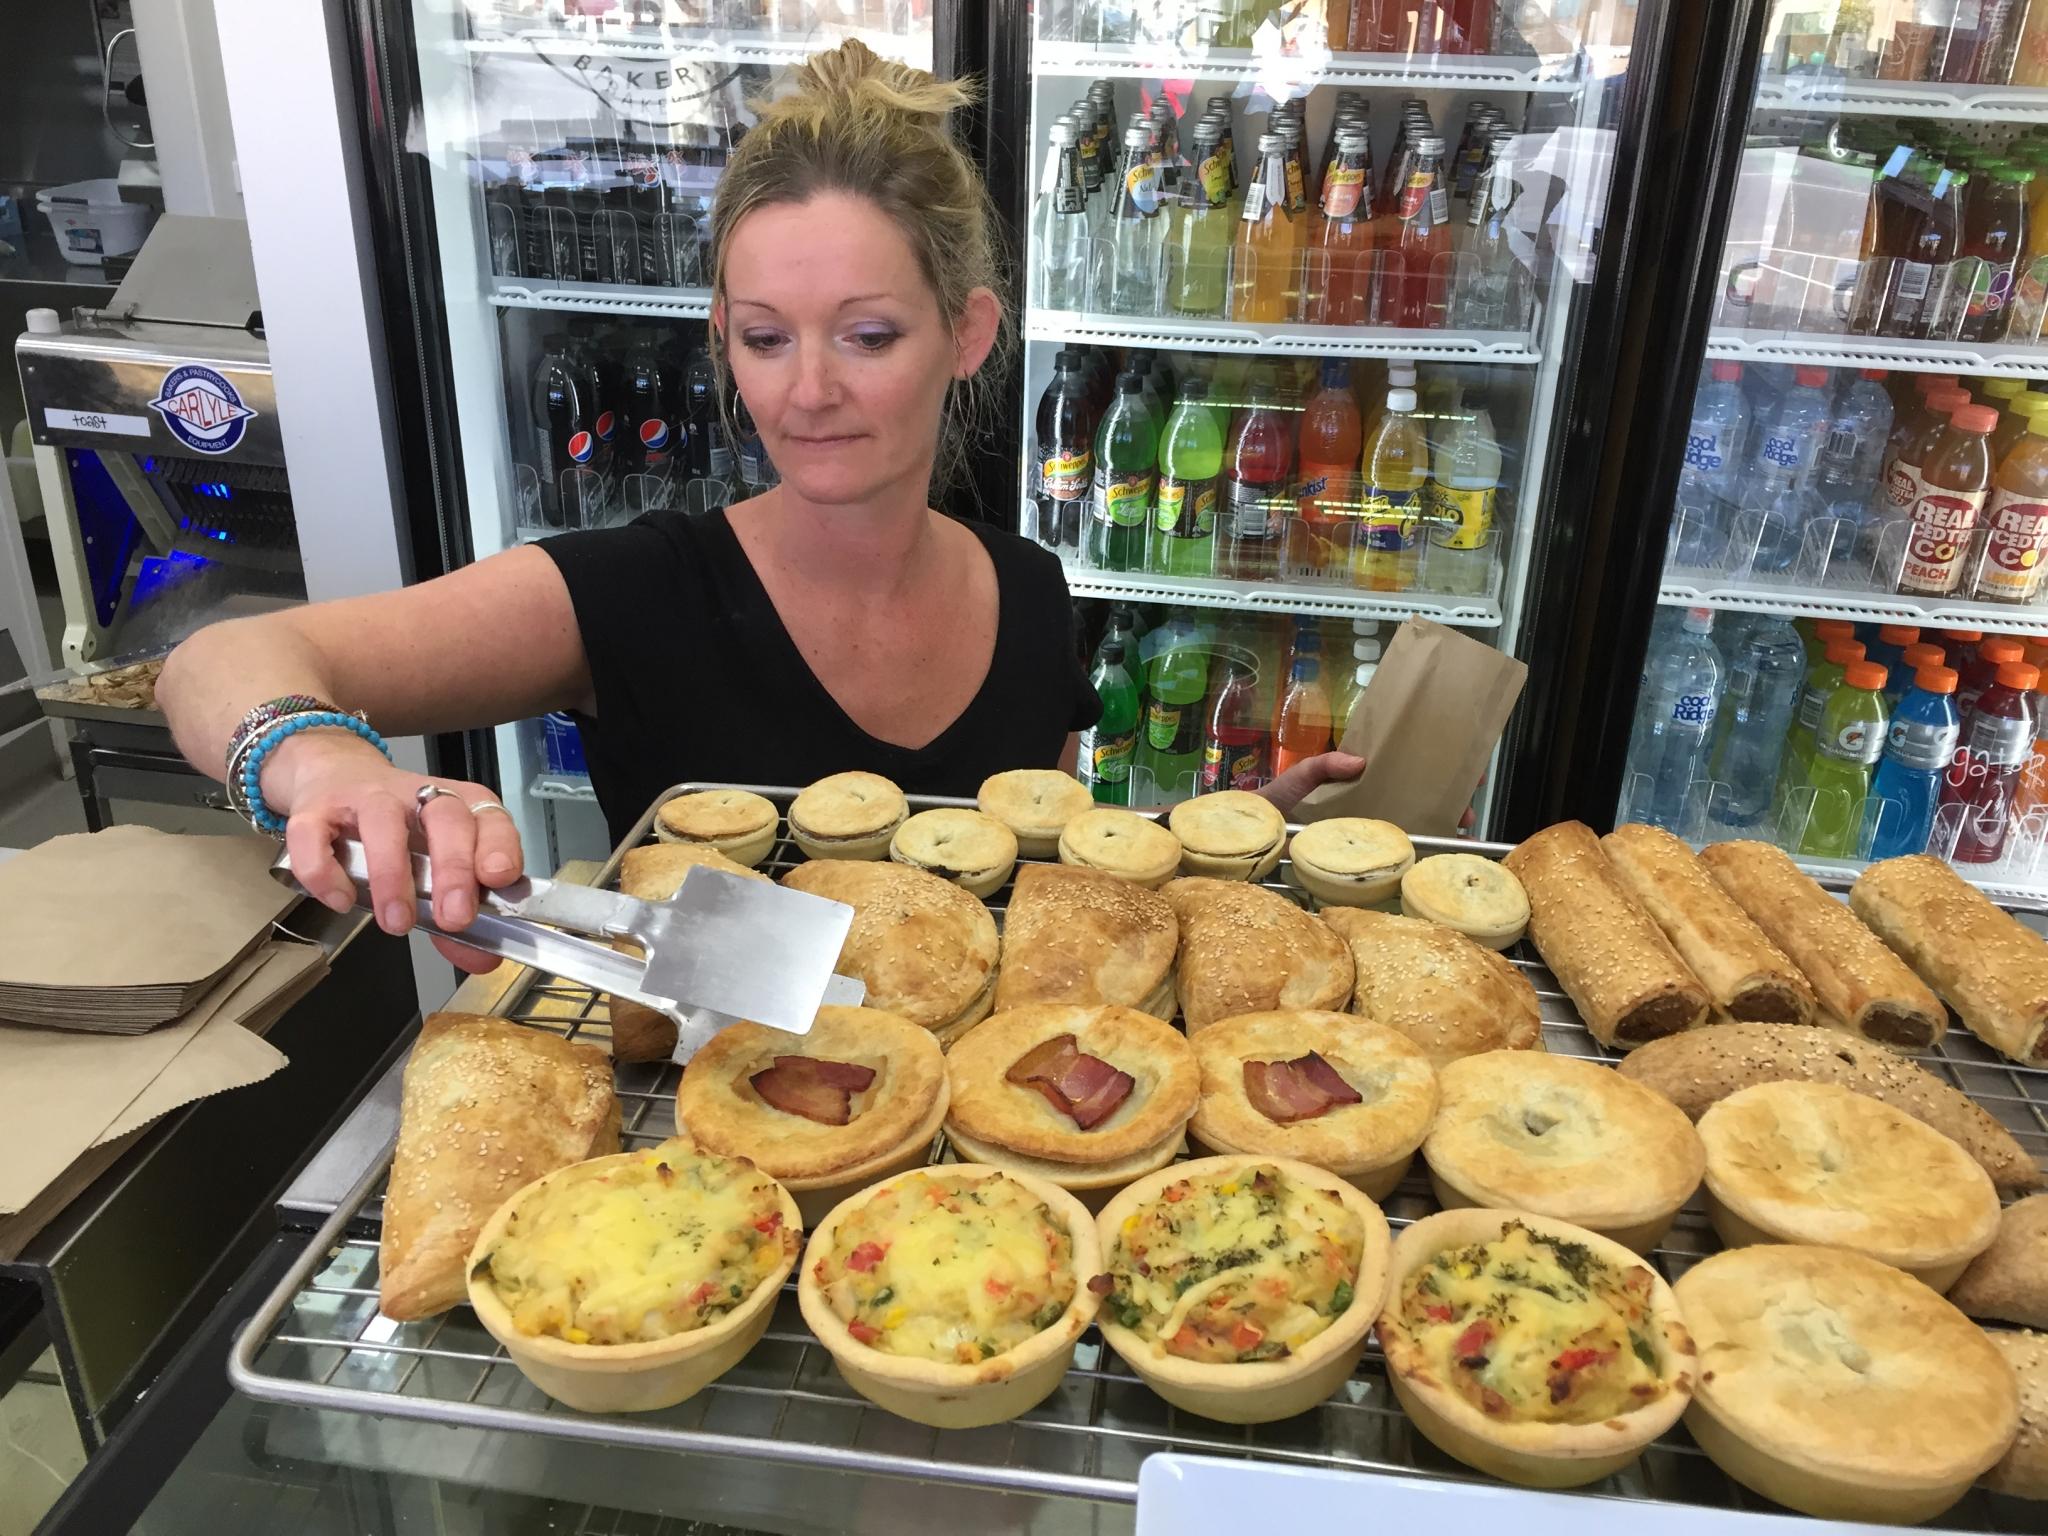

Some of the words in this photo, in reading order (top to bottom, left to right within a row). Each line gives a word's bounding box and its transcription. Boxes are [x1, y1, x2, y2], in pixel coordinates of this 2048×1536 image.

[164, 373, 183, 398] BAKERS
[189, 369, 236, 402] PASTRYCOOKS
[168, 390, 238, 427] CARLYLE
[72, 414, 107, 429] toast
[187, 435, 228, 449] EQUIPMENT
[1686, 448, 1722, 470] idge
[1764, 444, 1798, 466] Ridge
[1915, 499, 1975, 529] REAL
[1998, 509, 2048, 536] REA
[1905, 561, 1951, 580] PEACH
[1672, 703, 1715, 724] Ridge
